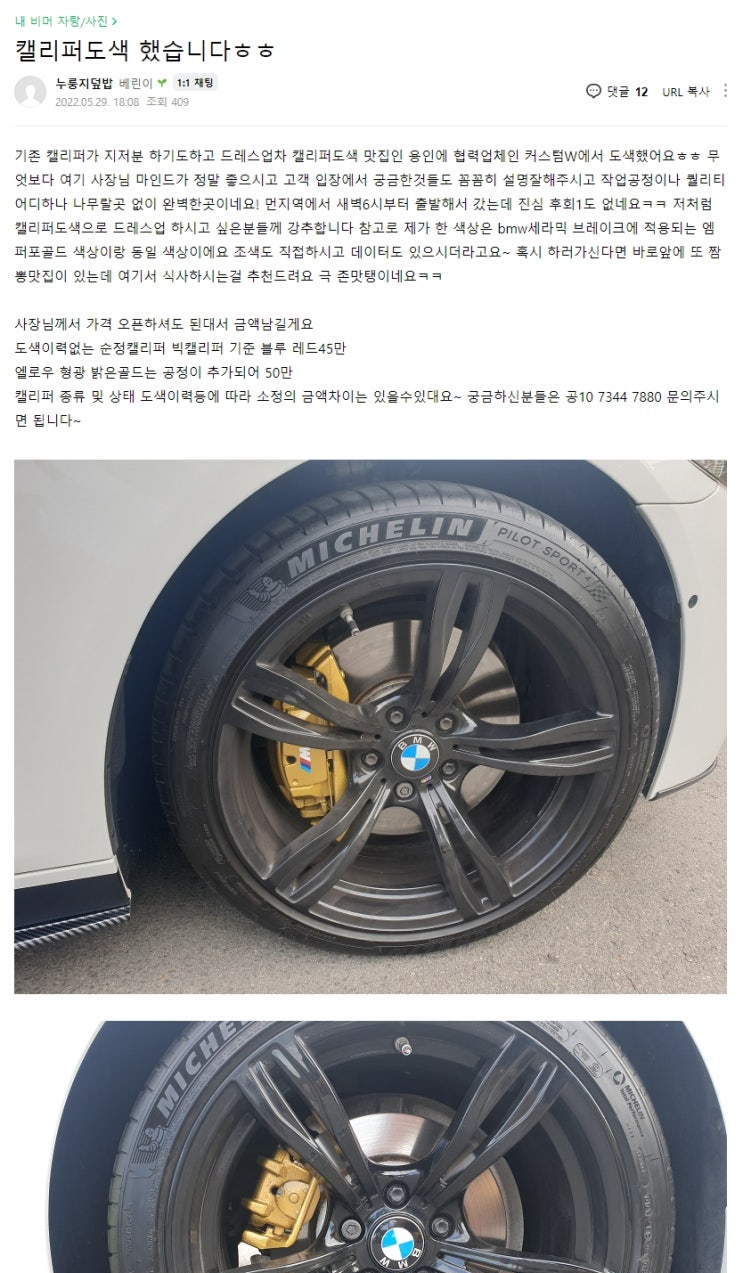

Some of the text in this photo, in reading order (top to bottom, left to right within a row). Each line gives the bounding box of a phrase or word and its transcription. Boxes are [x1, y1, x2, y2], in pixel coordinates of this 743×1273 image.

[287, 517, 474, 579] MICHELIN
[497, 527, 541, 549] PILOT
[542, 546, 586, 576] SPORT
[398, 736, 437, 751] BMW
[157, 1020, 248, 1118] MICHE
[624, 1084, 645, 1120] MICHELIN
[380, 1247, 421, 1268] BMW
